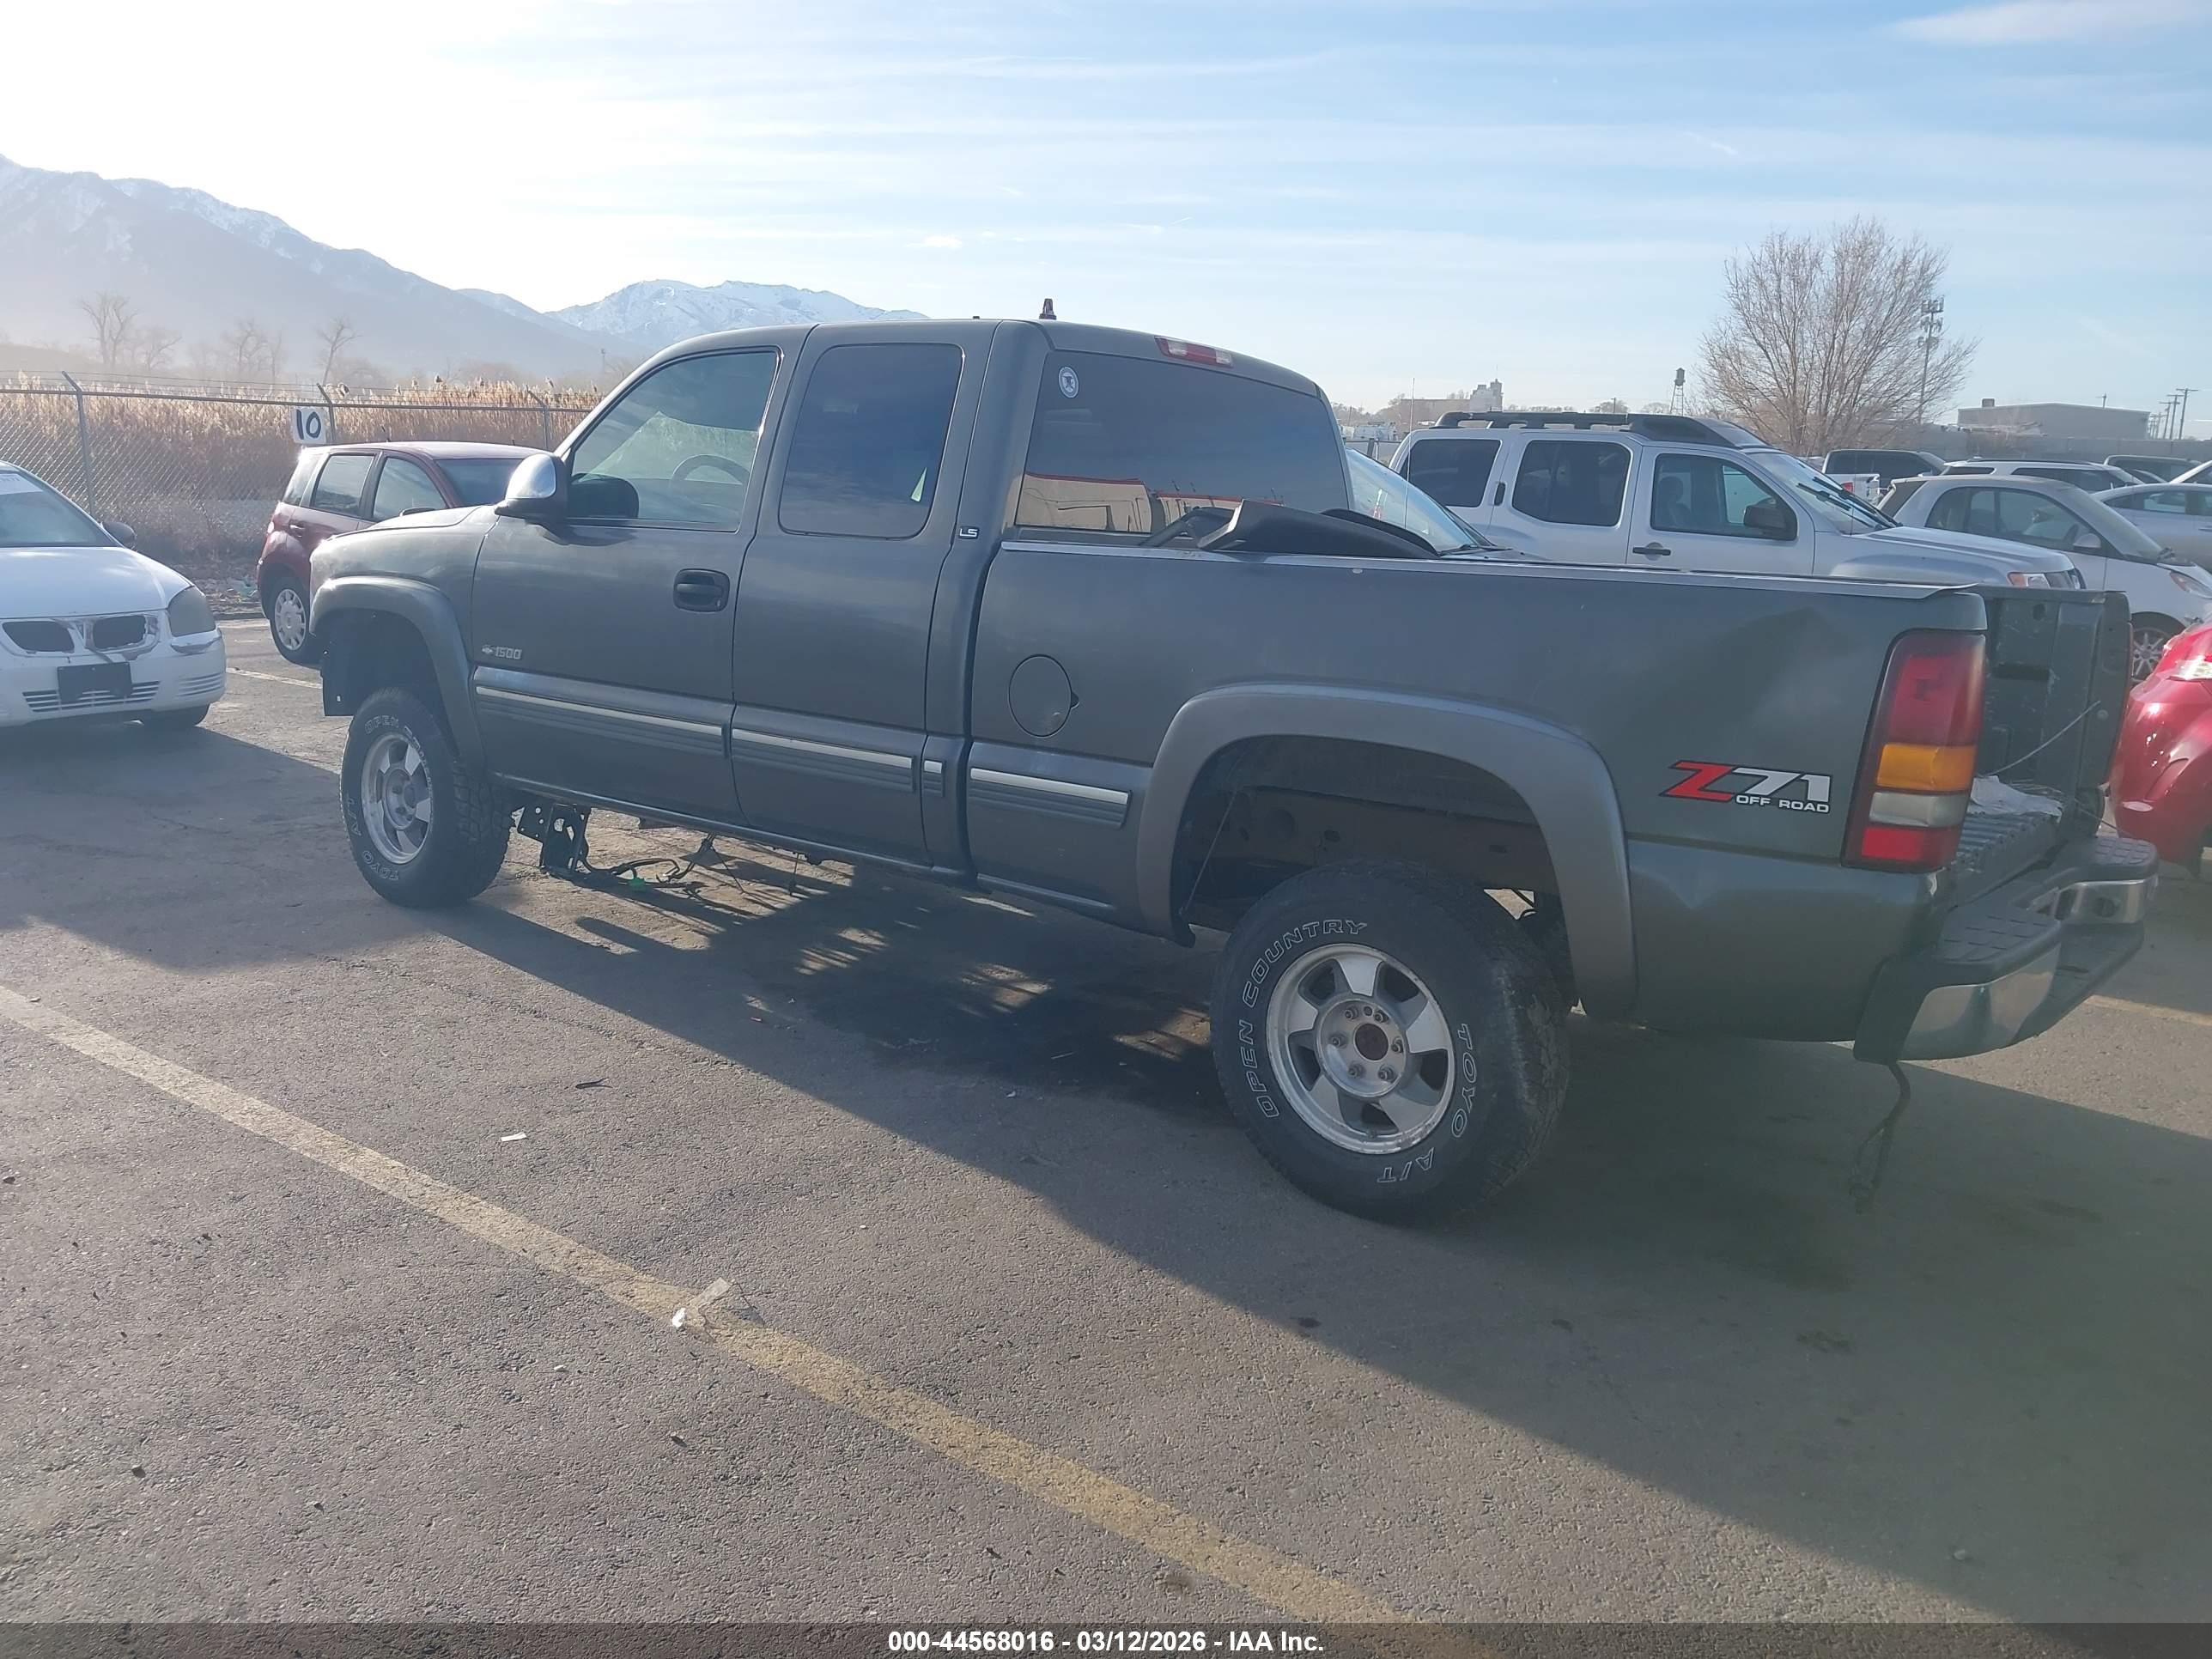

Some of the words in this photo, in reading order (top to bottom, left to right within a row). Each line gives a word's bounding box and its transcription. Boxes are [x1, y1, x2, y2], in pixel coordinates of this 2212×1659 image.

[296, 409, 322, 440] 10
[959, 528, 978, 538] LS
[495, 647, 522, 659] 1500
[1662, 761, 1832, 802] Z71
[1735, 794, 1771, 805] OFF
[1778, 799, 1830, 813] ROAD
[1243, 920, 1368, 1008] COUNTRY
[1238, 1019, 1279, 1118] OPEN
[1451, 1023, 1478, 1139] TOYO
[1376, 1147, 1435, 1183] A/T
